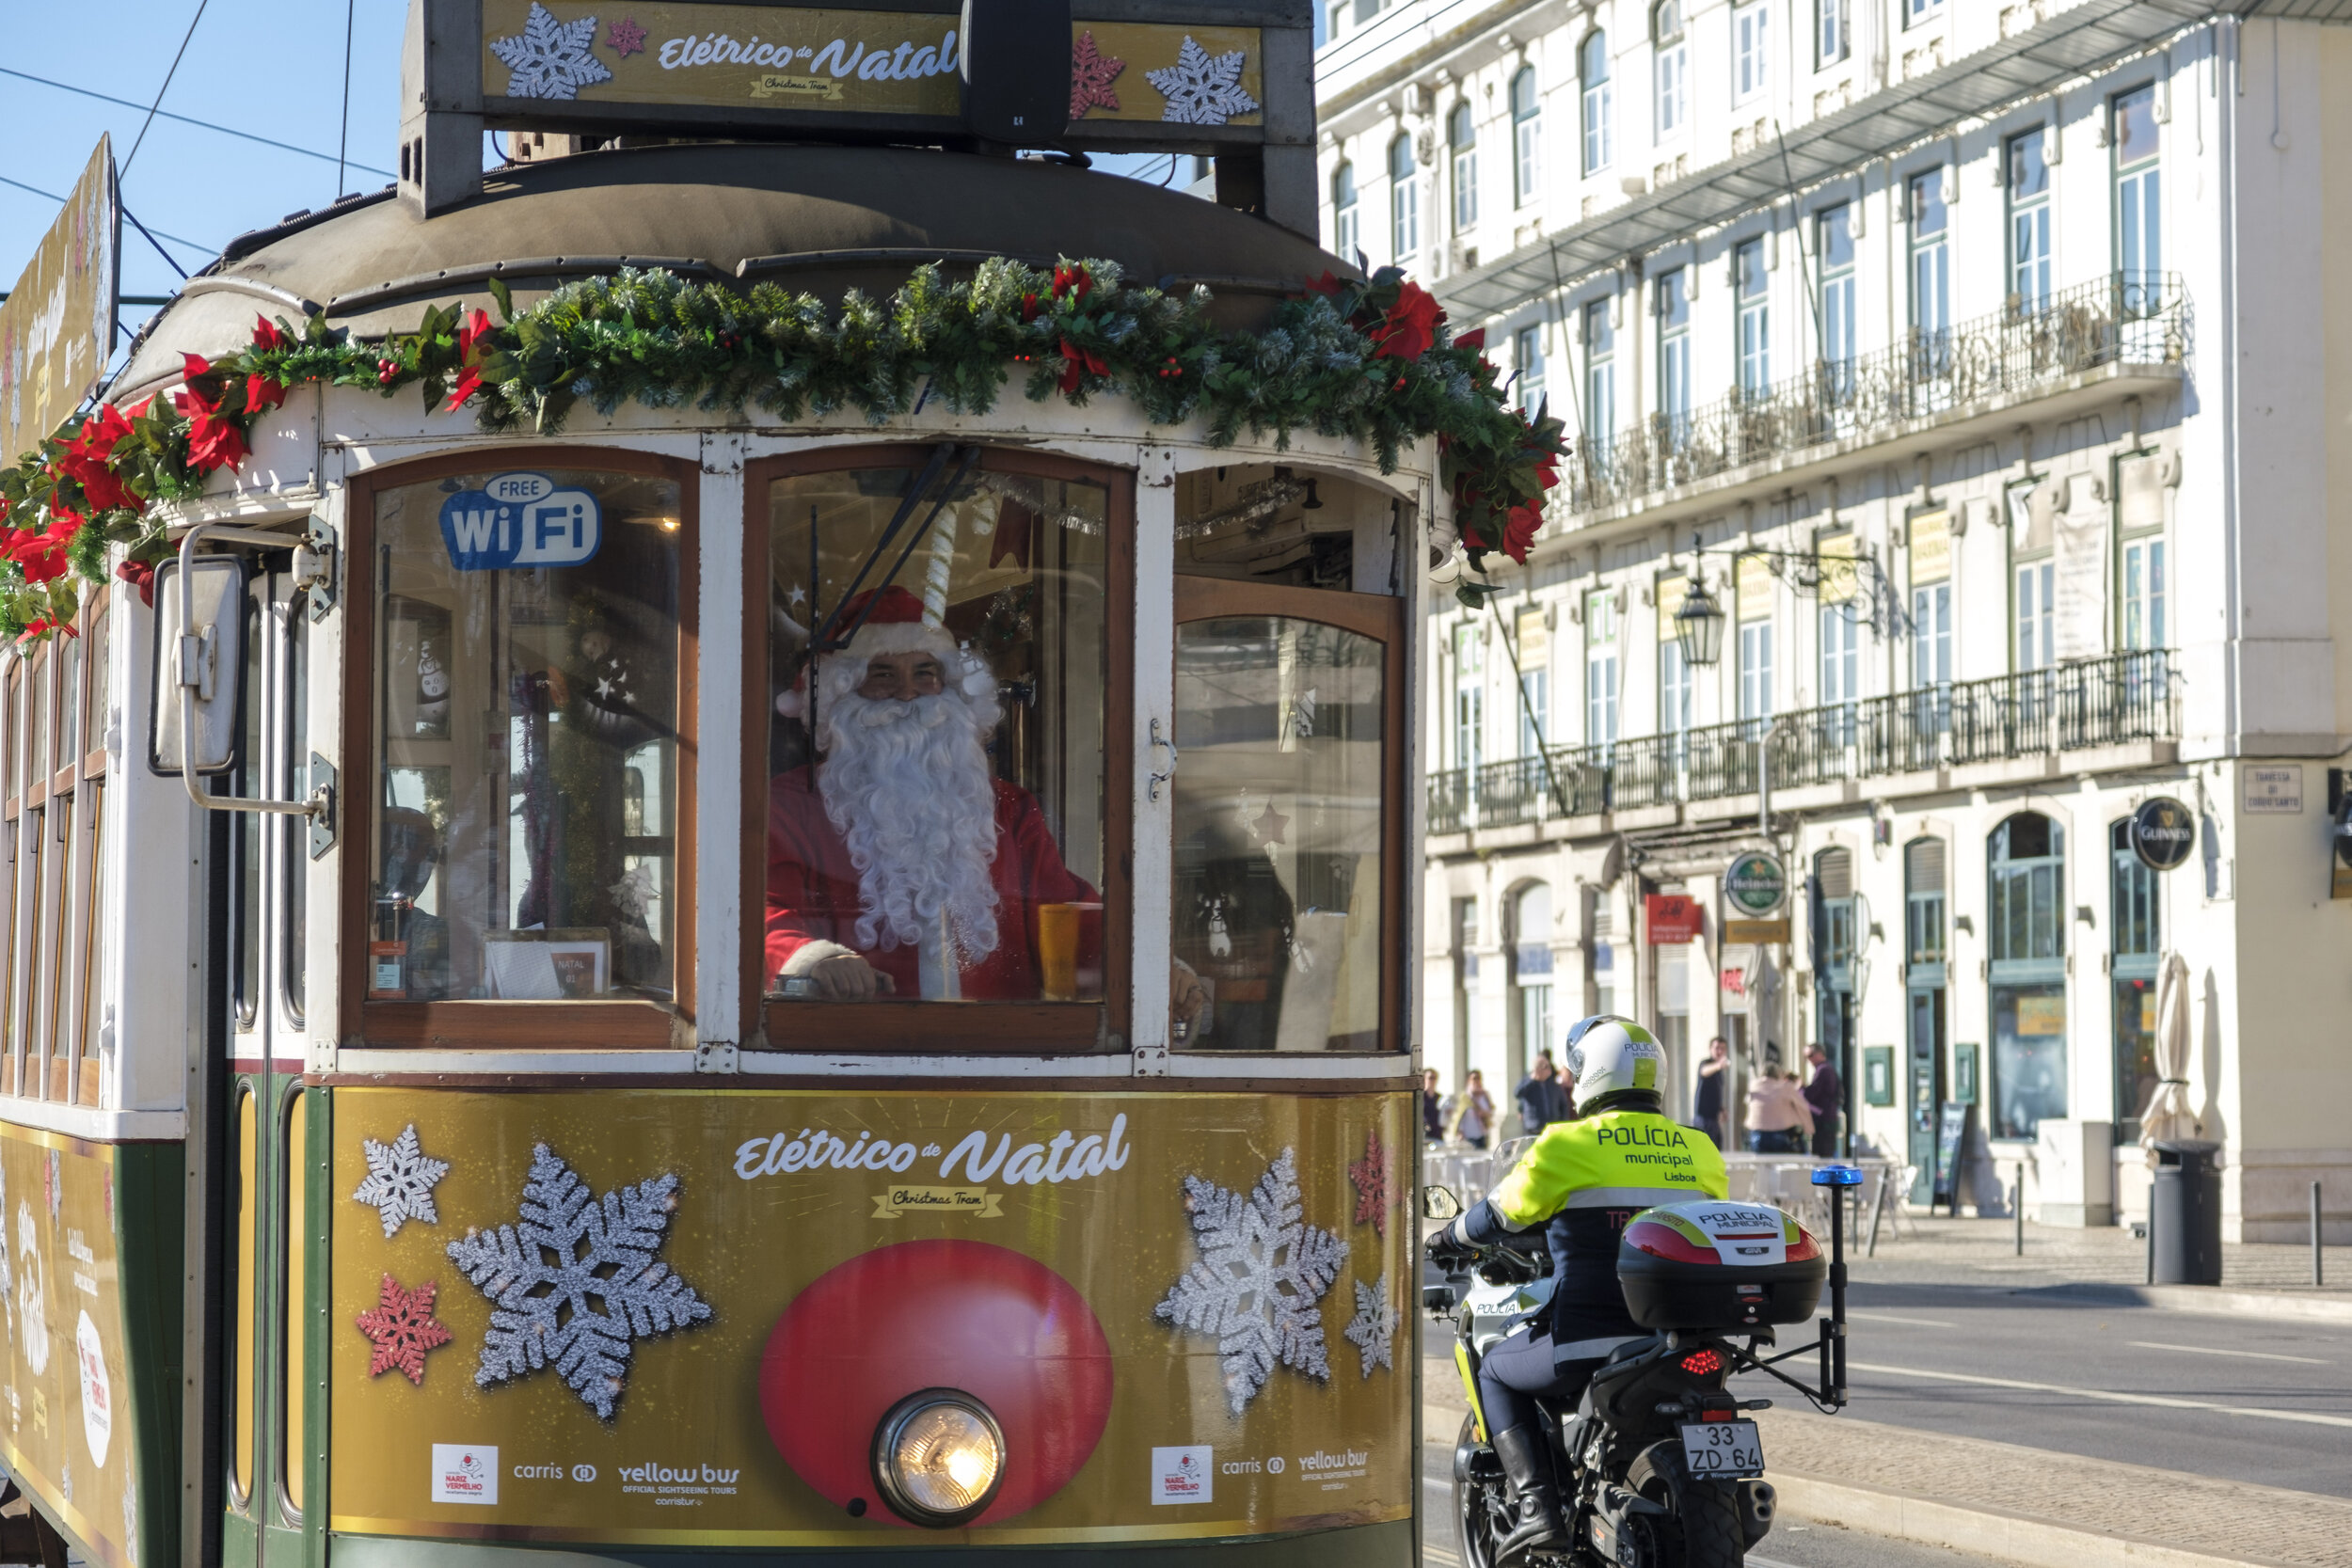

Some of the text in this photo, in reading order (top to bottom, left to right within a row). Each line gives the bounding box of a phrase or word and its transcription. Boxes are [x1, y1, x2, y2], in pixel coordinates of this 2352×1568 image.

[659, 29, 960, 82] Elétrico de Natal
[764, 77, 829, 91] Christmas Tram
[500, 480, 540, 497] FREE
[2141, 825, 2191, 841] GUINNESS
[557, 959, 585, 969] NATAL
[1597, 1125, 1689, 1149] POLÍCIA
[732, 1113, 1130, 1186] Elétrico de Natal
[1625, 1152, 1694, 1168] municipal
[1664, 1172, 1696, 1183] Lisboa
[892, 1190, 981, 1205] Christmas Tram
[1698, 1211, 1774, 1224] POLÍCIA
[1715, 1220, 1779, 1229] MUNICIPAL
[1707, 1426, 1735, 1447] 33
[1347, 1449, 1369, 1466] bus
[514, 1462, 564, 1480] carris
[701, 1464, 740, 1483] bus
[1222, 1457, 1262, 1475] carris
[445, 1482, 483, 1491] VERMELHO
[622, 1485, 657, 1494] OFFICIAL
[658, 1486, 708, 1495] SIGHTSEEING
